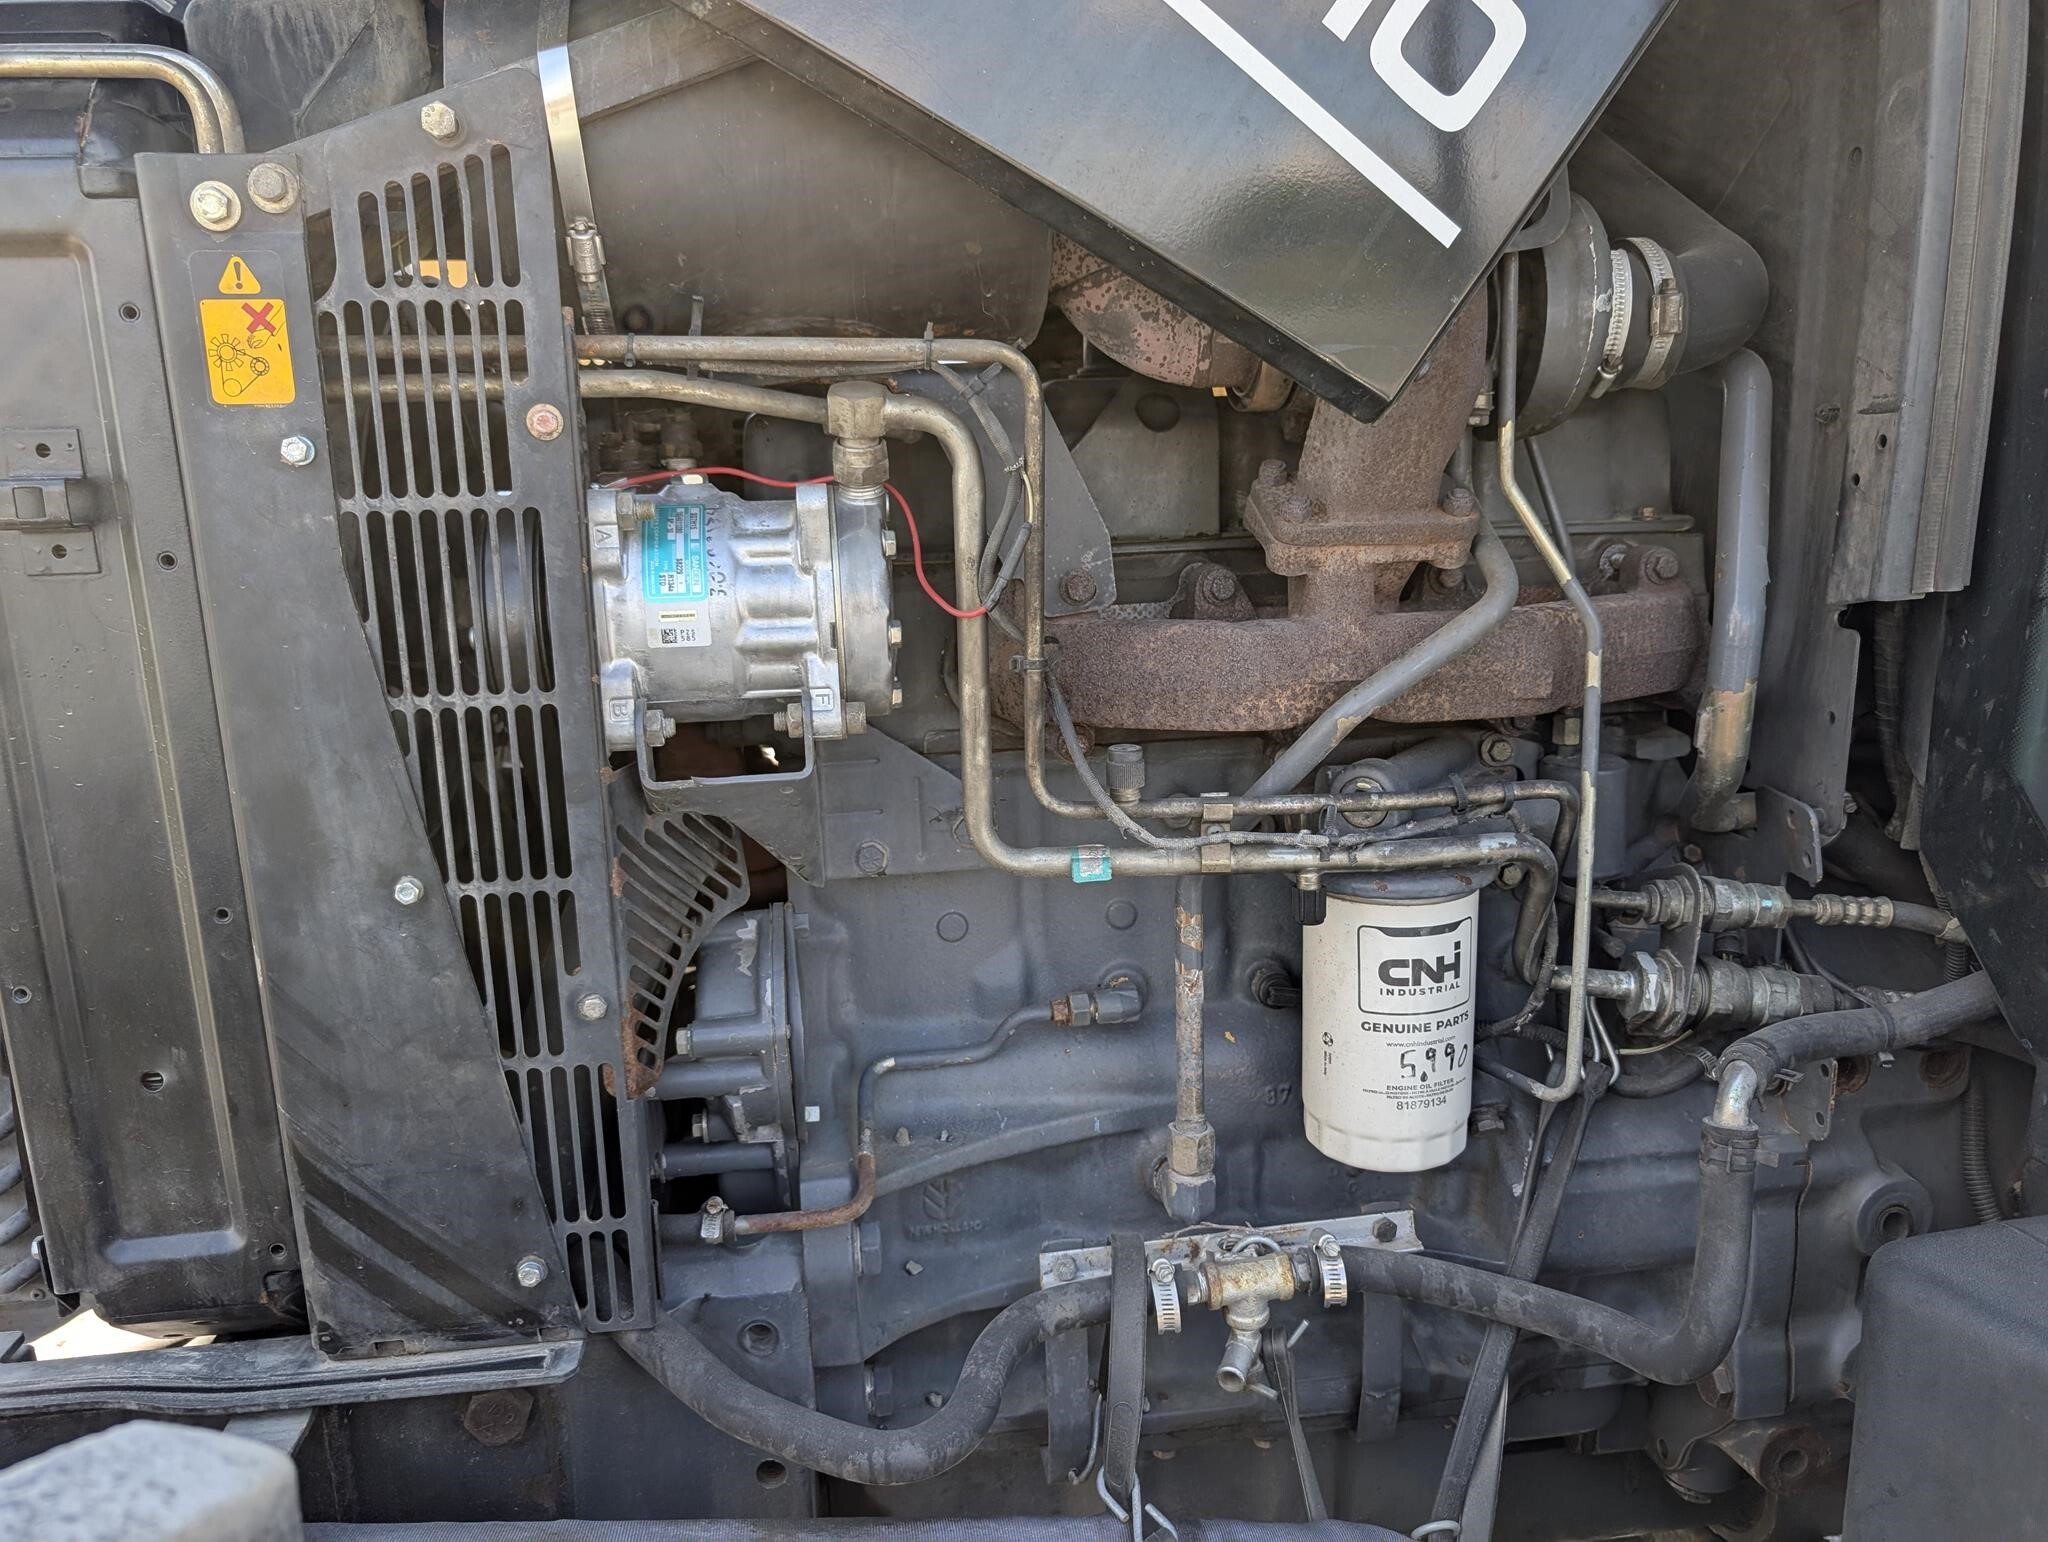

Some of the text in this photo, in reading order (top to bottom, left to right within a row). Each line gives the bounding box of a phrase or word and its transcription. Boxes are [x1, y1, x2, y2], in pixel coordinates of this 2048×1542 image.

[1379, 981, 1460, 996] INDUSTRIAL
[1361, 1010, 1469, 1034] GENUINE PARTS
[1386, 1035, 1456, 1048] www.cnhindustrial.com
[1419, 1082, 1432, 1090] OIL
[1433, 1077, 1455, 1087] FILTER
[1396, 1095, 1447, 1111] 81879134
